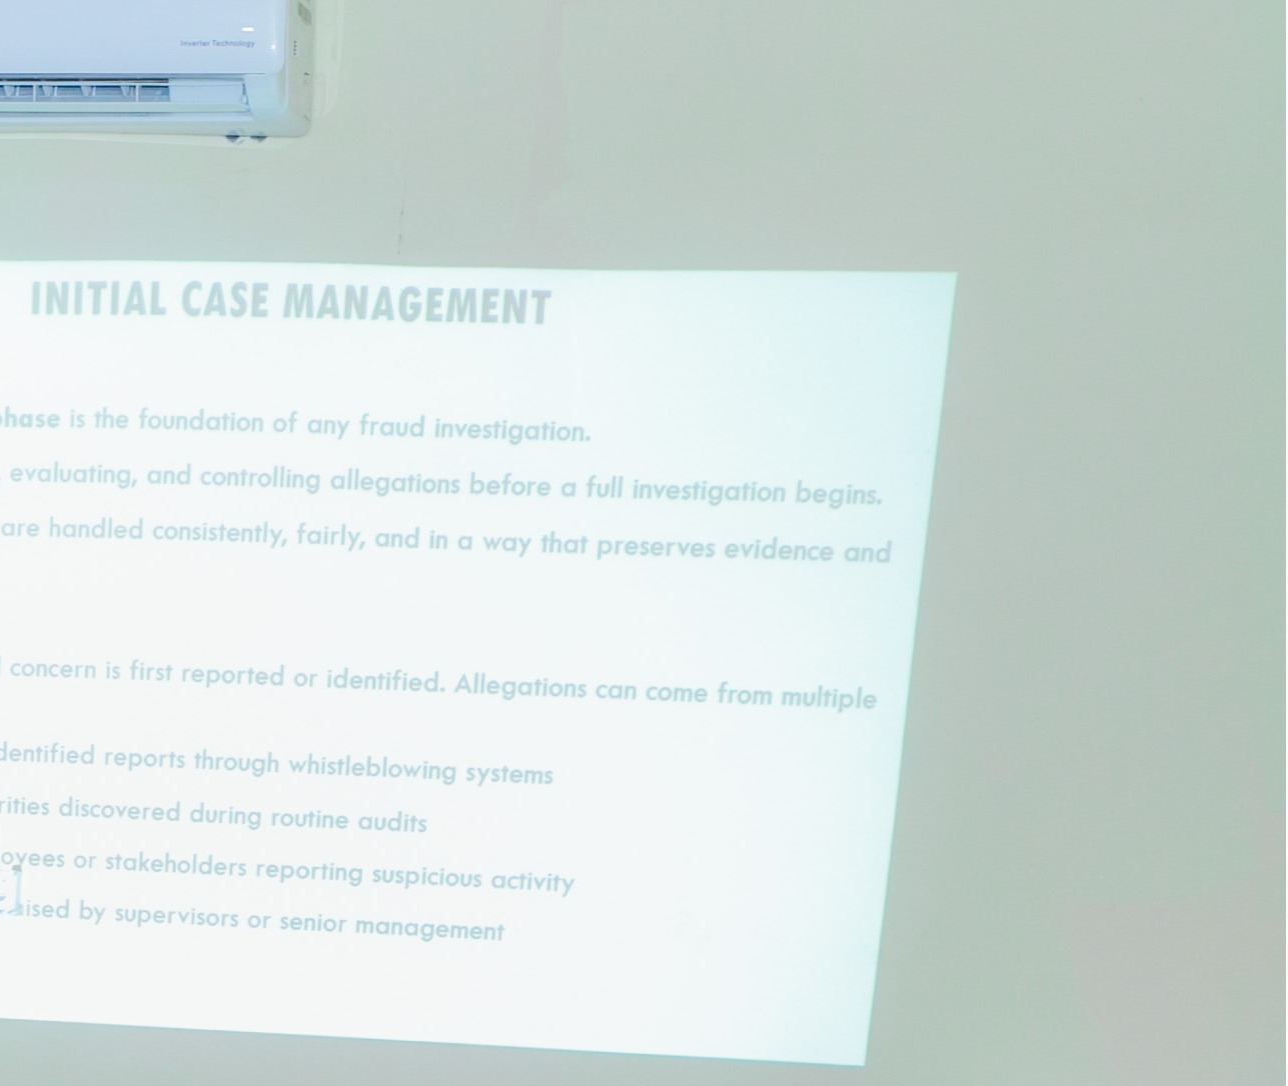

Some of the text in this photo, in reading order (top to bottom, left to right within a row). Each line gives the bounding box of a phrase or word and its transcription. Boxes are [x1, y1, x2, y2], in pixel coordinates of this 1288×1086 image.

[212, 40, 255, 48] Technology
[31, 280, 552, 325] INITIAL CASE MANAGEMENT
[69, 409, 86, 429] is
[94, 406, 129, 429] the
[138, 407, 264, 432] foundation
[272, 410, 298, 433] of
[306, 419, 350, 440] any
[359, 412, 426, 438] fraud
[434, 418, 591, 446] investigation.
[10, 461, 137, 490] evaluating,
[147, 463, 192, 485] and
[199, 465, 321, 495] controlling
[329, 467, 461, 497] allegations
[469, 471, 551, 497] before
[560, 481, 577, 498] a
[586, 474, 624, 499] full
[632, 479, 786, 507] investigation
[795, 479, 882, 509] begins.
[0, 522, 40, 538] are
[49, 516, 144, 540] handled
[152, 521, 287, 549] consistently,
[296, 522, 366, 552] fairly,
[374, 526, 420, 549] and
[429, 529, 449, 550] in
[457, 535, 473, 551] a
[482, 536, 532, 558] way
[540, 530, 589, 555] that
[596, 539, 716, 560] preserves
[723, 536, 834, 562] evidence
[844, 540, 892, 563] and
[10, 662, 97, 679] concern
[106, 661, 121, 680] is
[129, 659, 173, 682] first
[181, 664, 285, 688] reported
[293, 672, 318, 688] or
[326, 667, 446, 693] identified.
[453, 672, 587, 701] Allegations
[595, 684, 638, 700] can
[645, 685, 708, 703] come
[717, 681, 773, 705] from
[780, 685, 877, 714] multiple
[104, 751, 185, 772] reports
[194, 748, 280, 778] through
[288, 753, 457, 786] whistleblowing
[466, 765, 554, 787] systems
[58, 796, 181, 822] discovered
[189, 802, 262, 831] during
[271, 810, 349, 830] routine
[357, 810, 428, 833] audits
[73, 855, 97, 869] or
[105, 851, 247, 877] stakeholders
[256, 862, 363, 887] reporting
[372, 866, 483, 890] suspicious
[491, 872, 575, 898] activity
[79, 899, 106, 925] by
[115, 907, 239, 928] supervisors
[247, 914, 272, 929] or
[280, 913, 347, 933] senior
[355, 919, 505, 943] management
